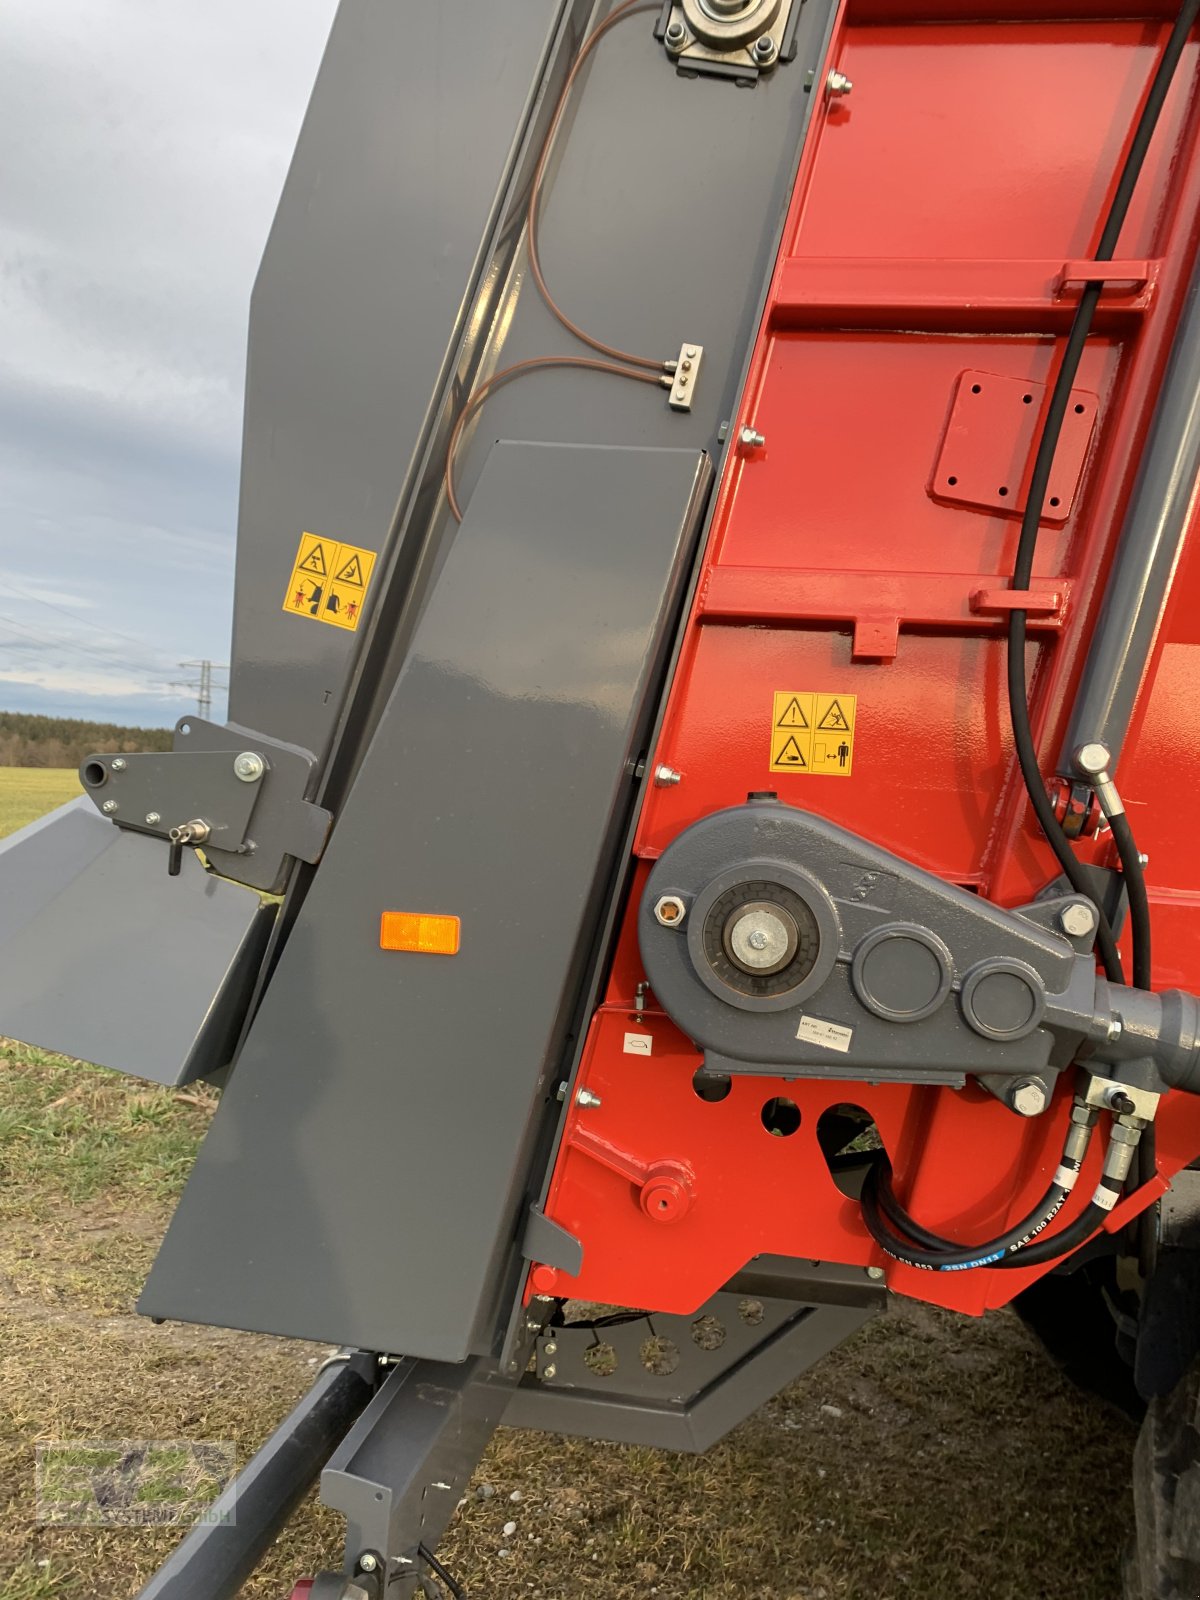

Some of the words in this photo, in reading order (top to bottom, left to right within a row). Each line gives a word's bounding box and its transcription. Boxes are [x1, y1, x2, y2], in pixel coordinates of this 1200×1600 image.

[944, 1262, 968, 1272] 2SN
[971, 1253, 1000, 1268] DN13
[1009, 1235, 1031, 1252] SAE
[1031, 1221, 1047, 1236] 100
[1046, 1194, 1066, 1221] R2AT
